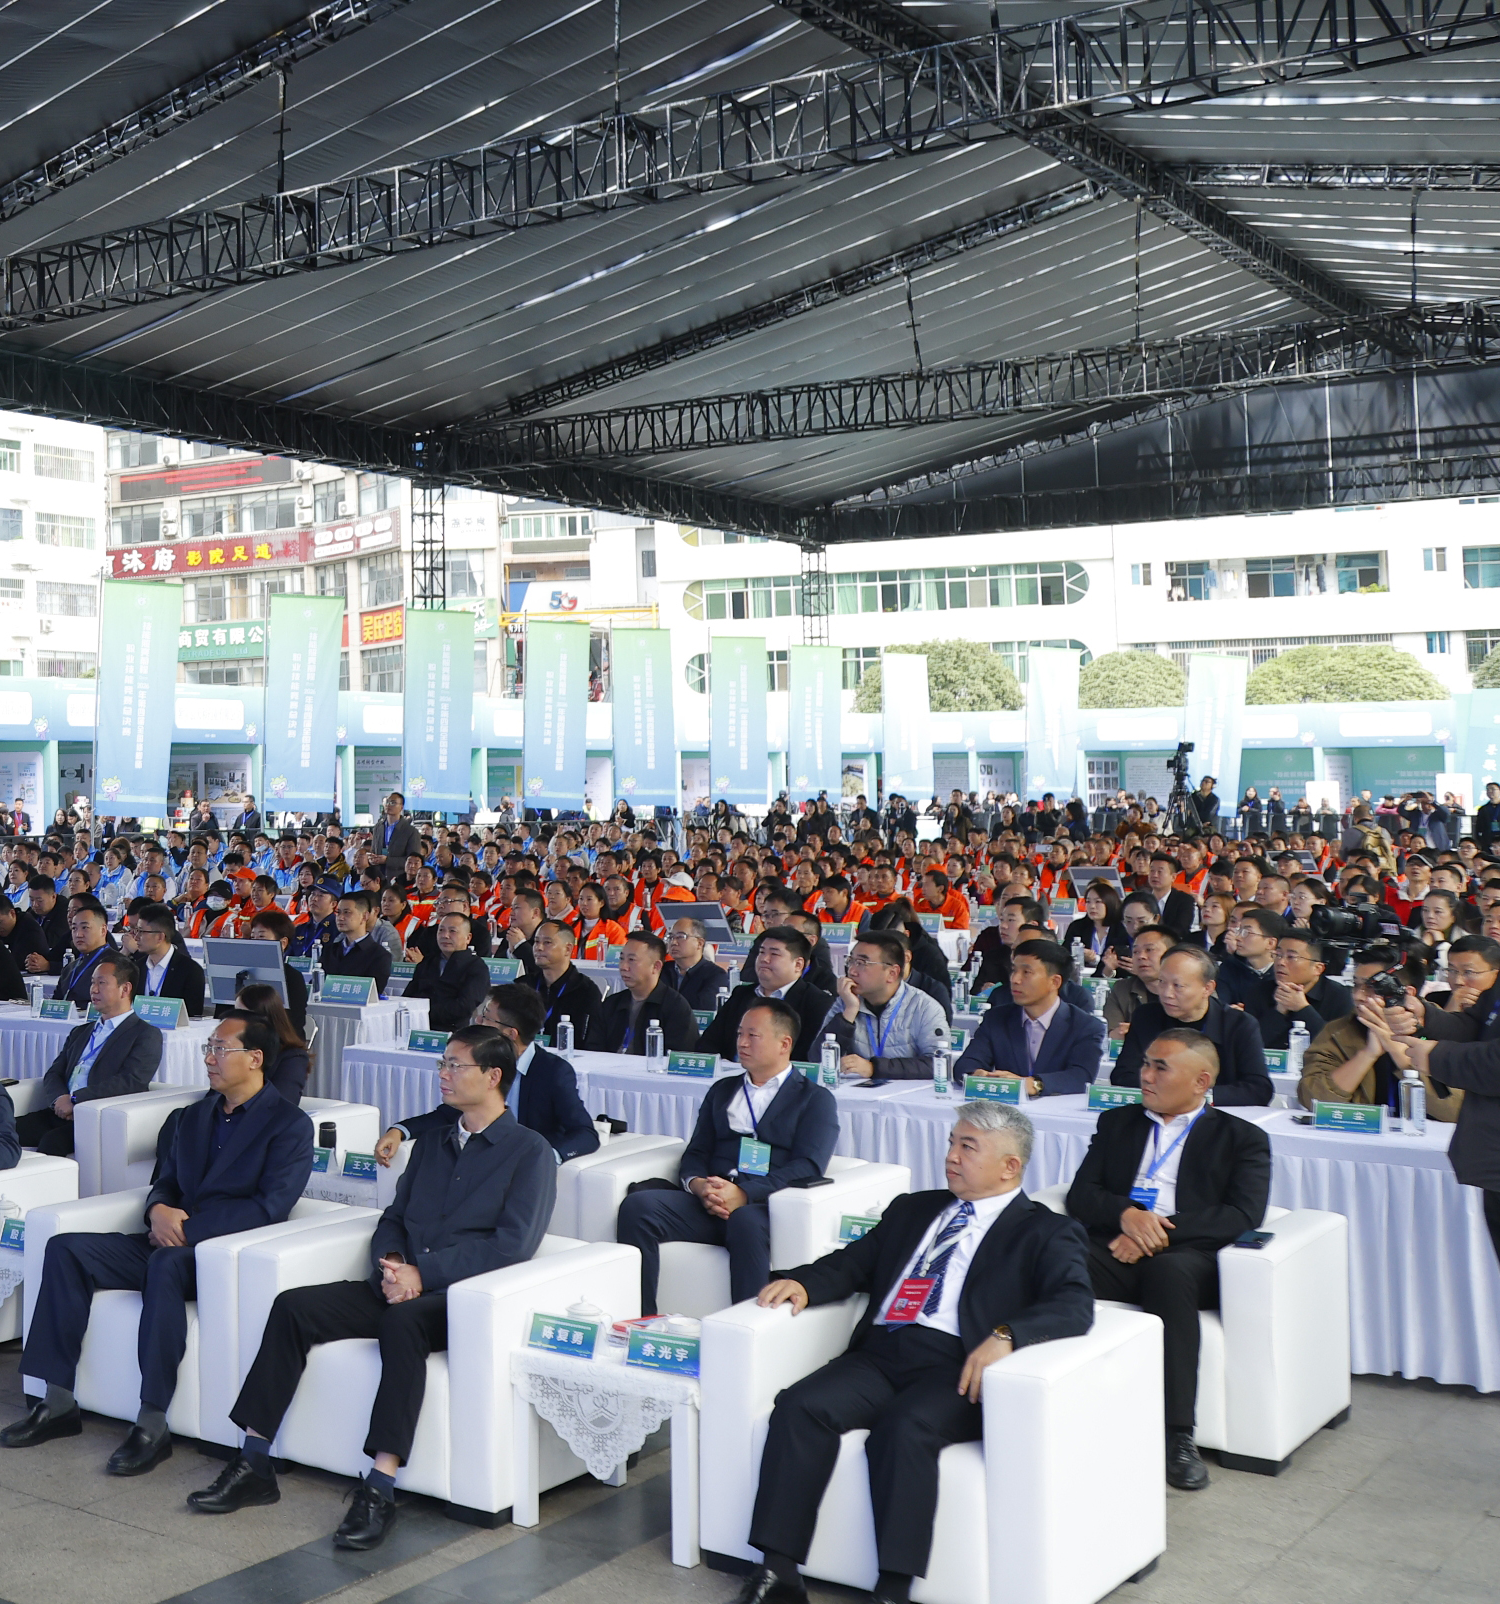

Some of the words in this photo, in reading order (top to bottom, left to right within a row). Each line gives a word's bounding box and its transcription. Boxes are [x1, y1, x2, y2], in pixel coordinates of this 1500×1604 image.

[186, 543, 272, 566] 影院足道
[549, 590, 578, 611] 5G
[178, 626, 271, 648] 商贸有限公
[330, 982, 362, 994] 第四排
[140, 1004, 172, 1016] 第三排
[541, 1324, 585, 1346] 陈复勇
[641, 1341, 689, 1362] 余光宇
